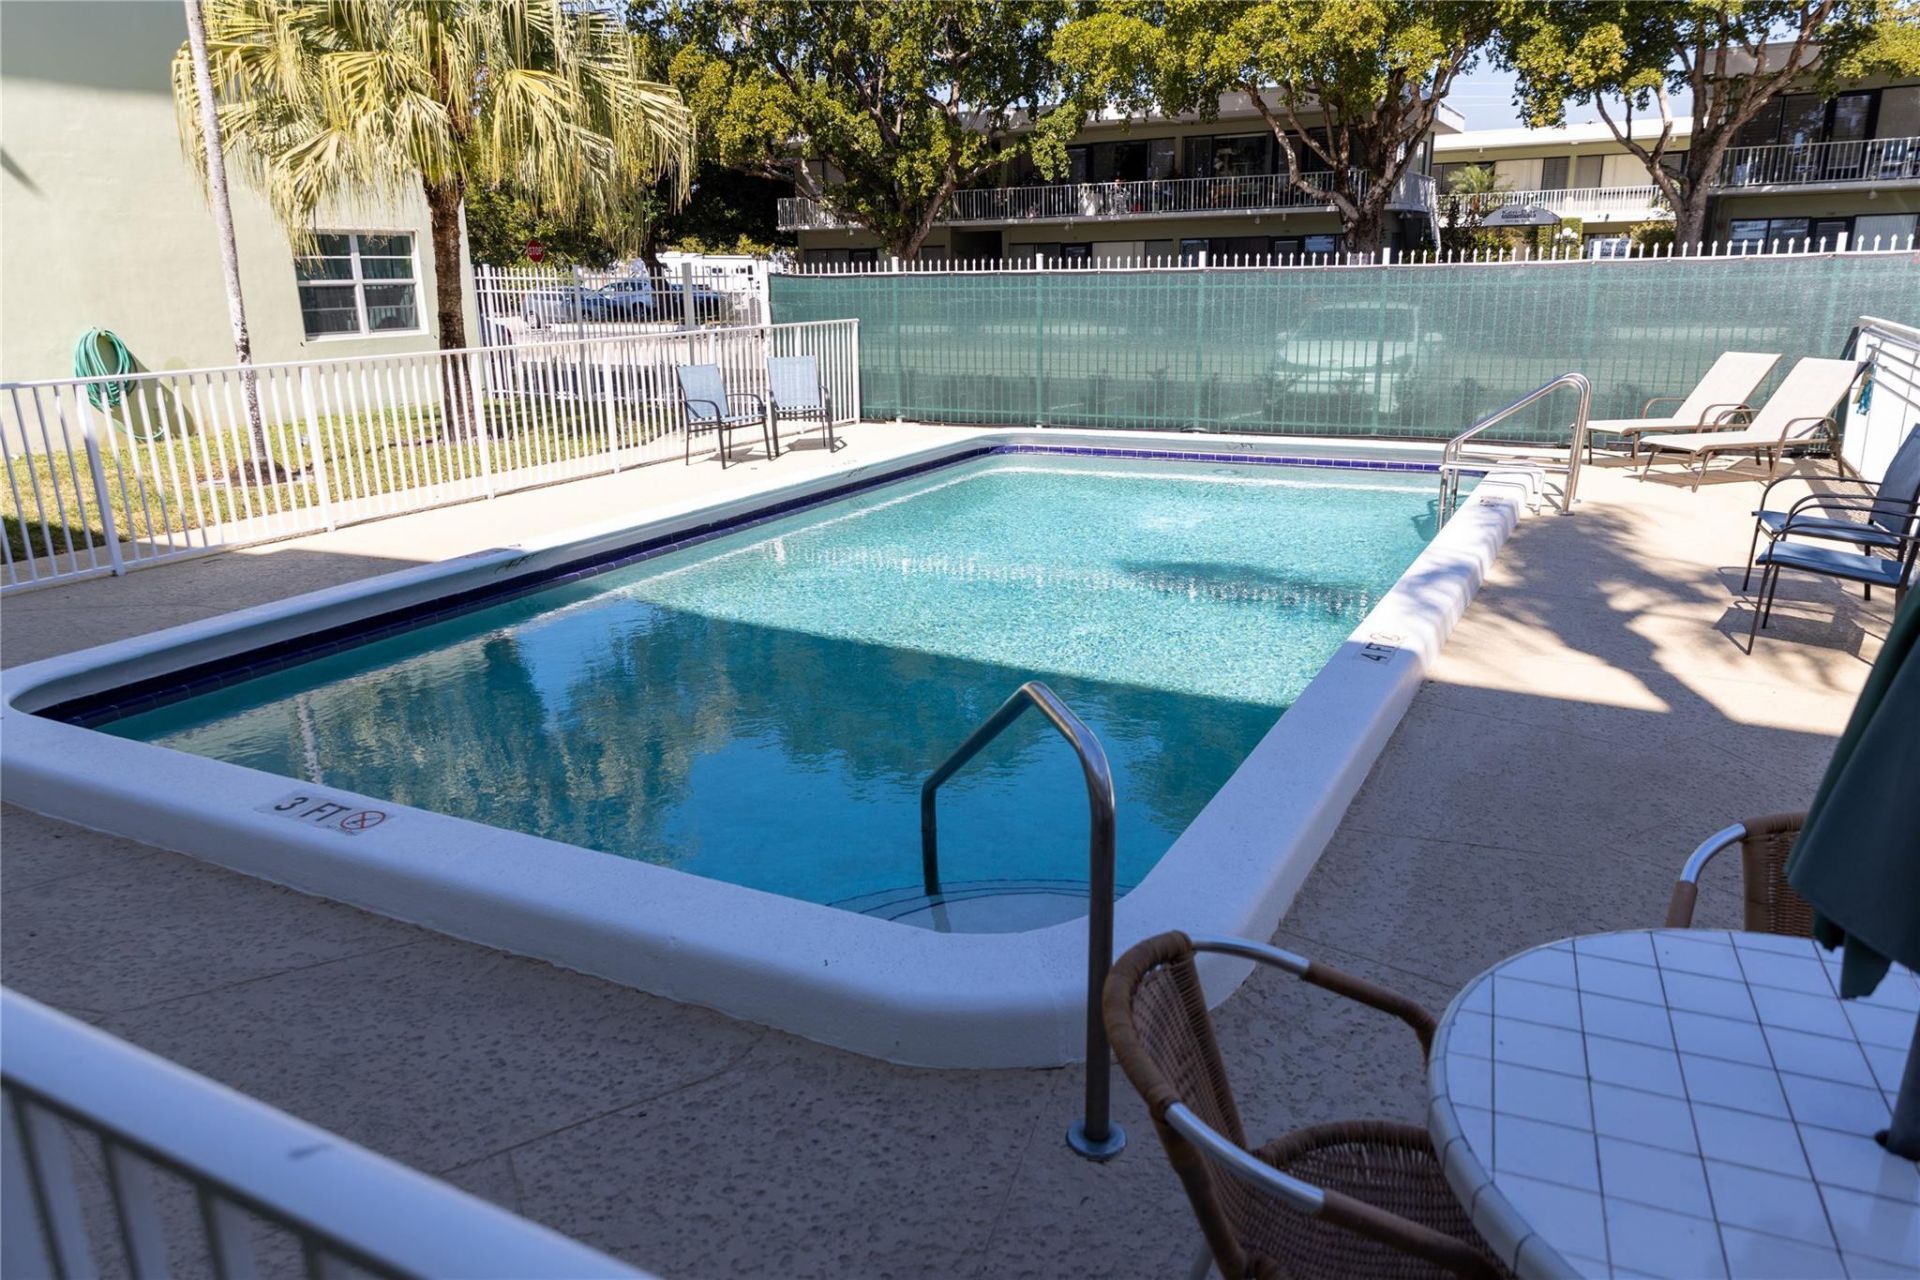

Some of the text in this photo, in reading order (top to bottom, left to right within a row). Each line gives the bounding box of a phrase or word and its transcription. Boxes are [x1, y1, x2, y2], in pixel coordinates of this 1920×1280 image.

[528, 246, 543, 256] STOP
[1361, 642, 1395, 661] 4 FT
[274, 797, 352, 822] 3 FT
